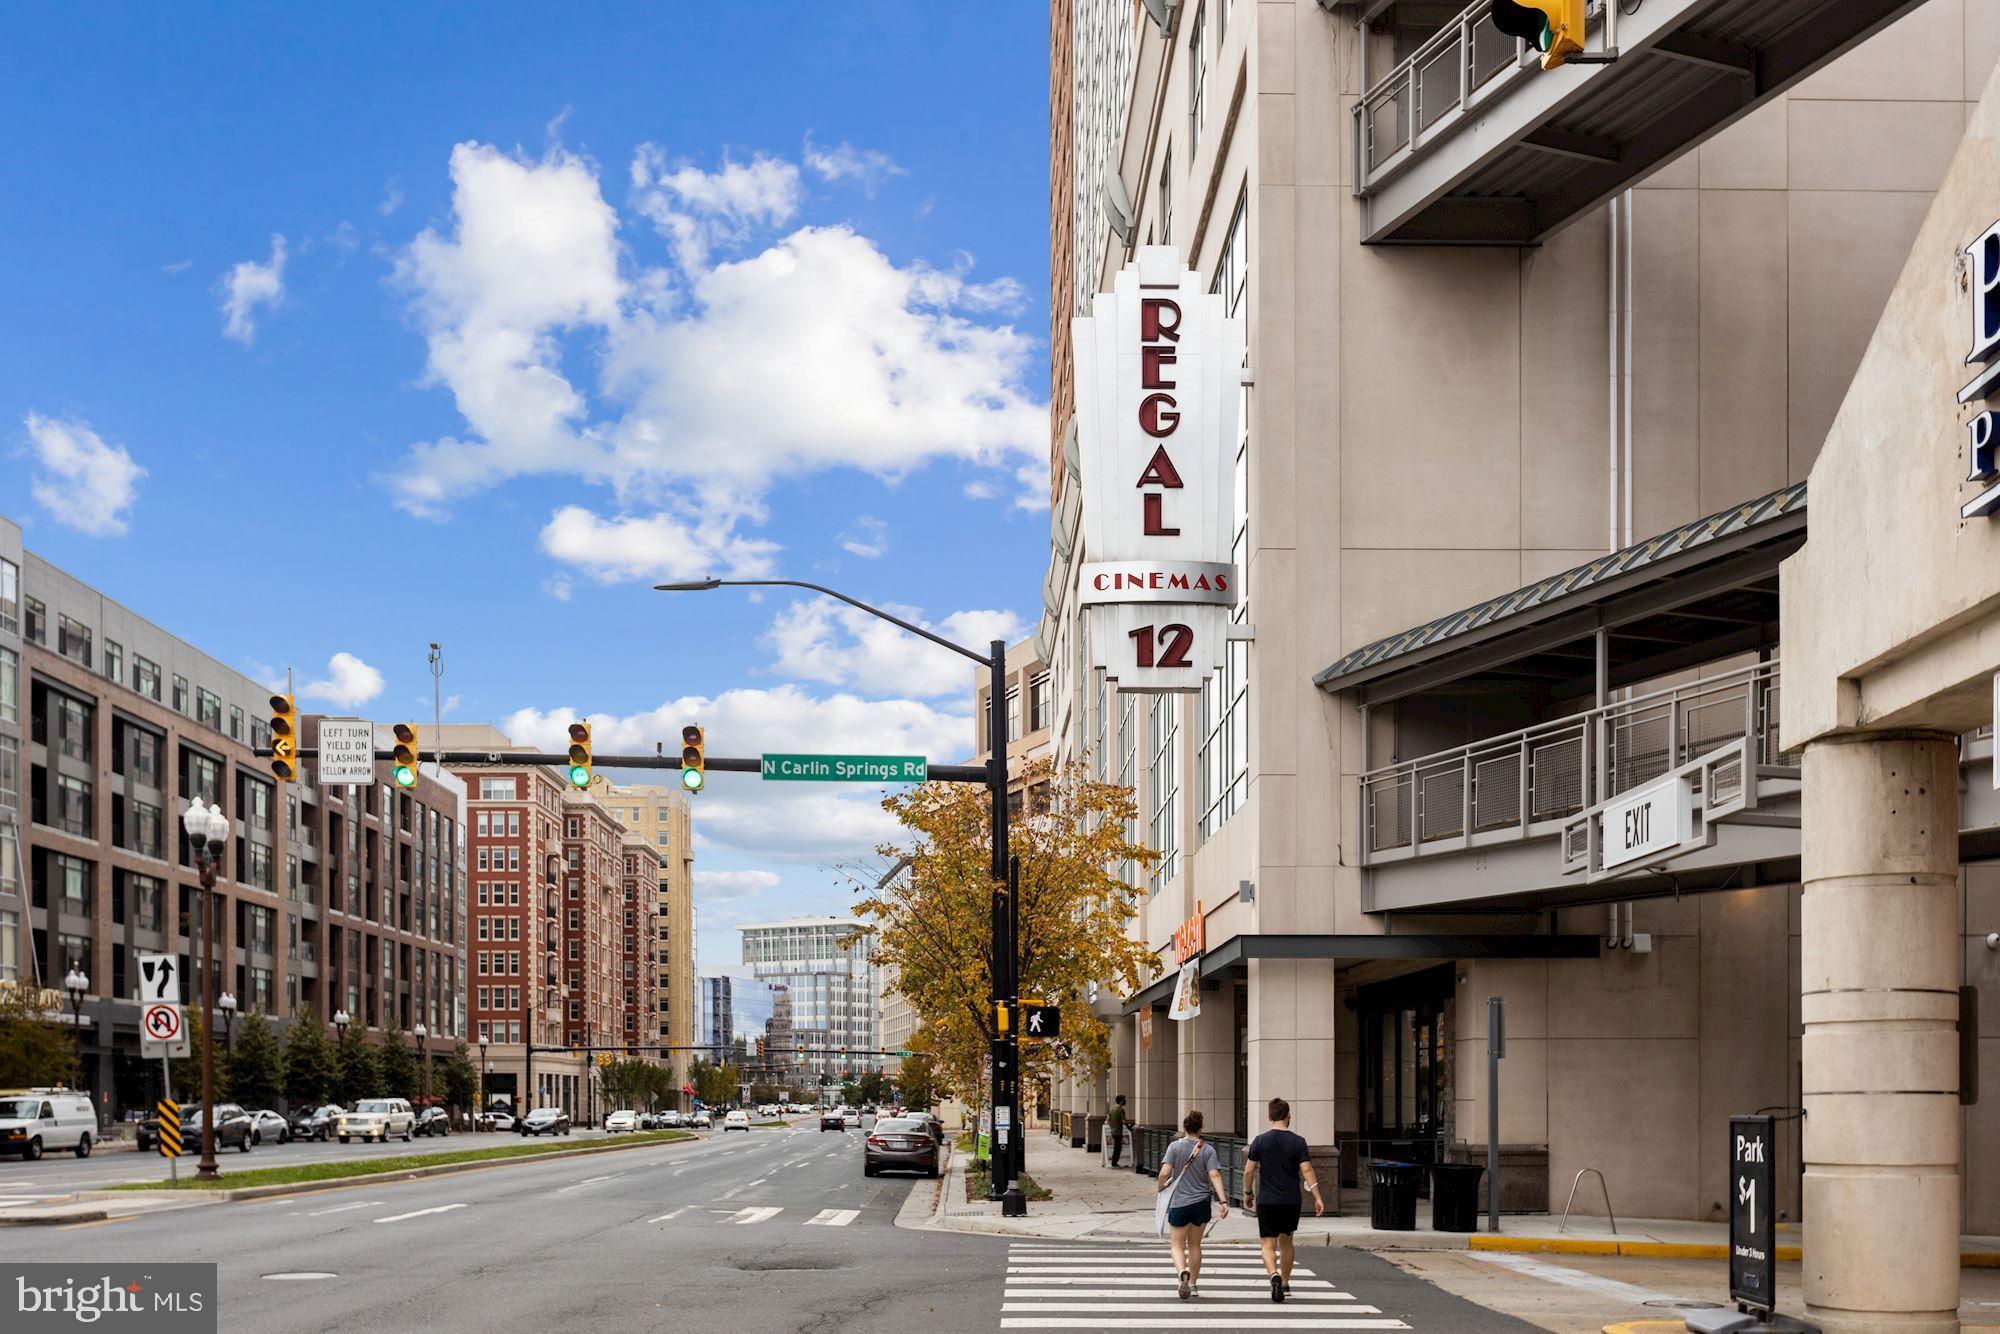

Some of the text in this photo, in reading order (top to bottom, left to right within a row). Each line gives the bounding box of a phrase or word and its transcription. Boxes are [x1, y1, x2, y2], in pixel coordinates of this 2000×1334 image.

[1136, 297, 1184, 537] REGAL
[1093, 572, 1228, 592] CINEMAS
[1128, 623, 1193, 668] 12
[323, 728, 369, 738] LEFT TURN
[326, 741, 367, 750] YIELD ON
[326, 754, 367, 763] FLASHING
[322, 766, 371, 776] YELLOW ARROW
[763, 760, 924, 779] N Carlin Springs Rd
[1626, 802, 1651, 850] EXIT
[1736, 1135, 1764, 1162] Park
[1739, 1175, 1756, 1234] $1
